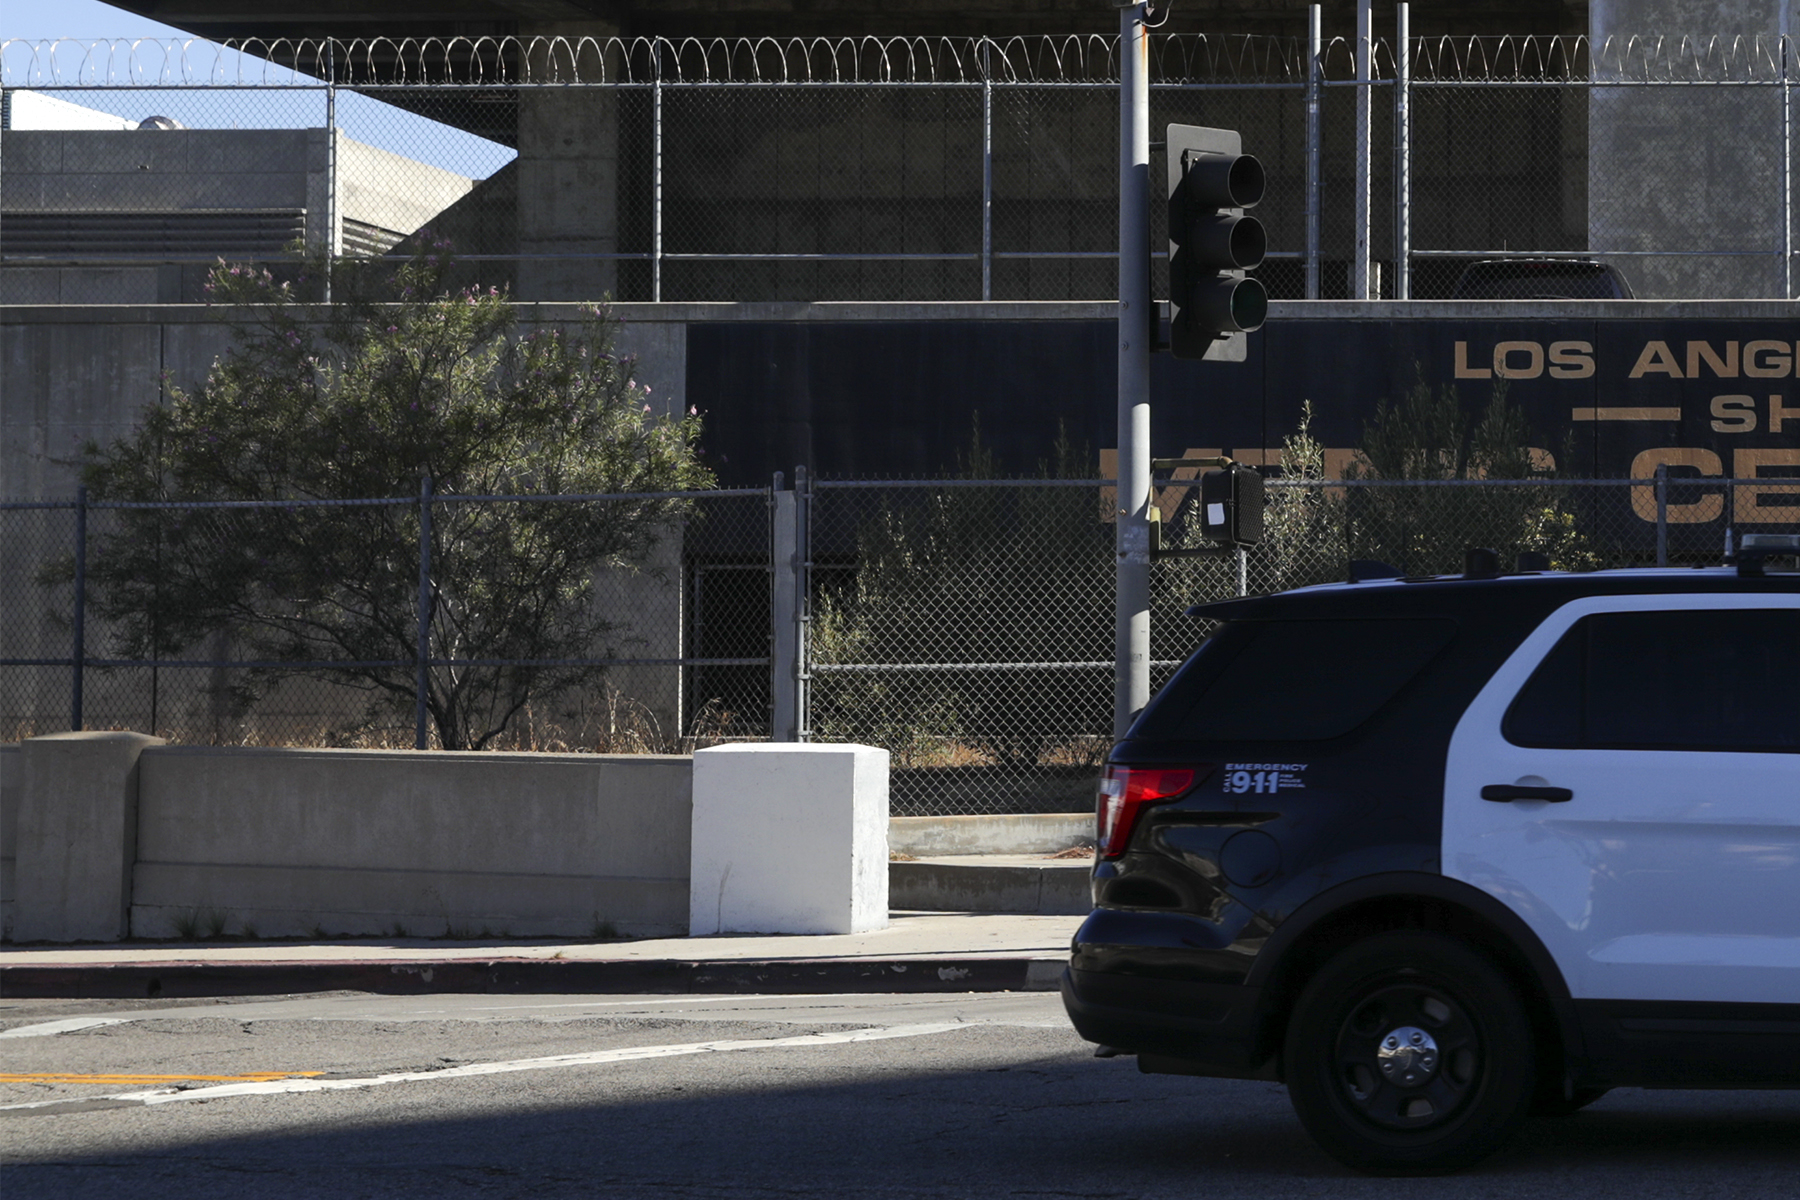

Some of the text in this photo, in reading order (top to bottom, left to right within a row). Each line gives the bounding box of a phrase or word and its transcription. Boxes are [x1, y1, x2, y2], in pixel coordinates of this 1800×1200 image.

[1454, 340, 1596, 379] LOS
[1225, 763, 1308, 771] EMERGENCY
[1223, 772, 1233, 793] CALL
